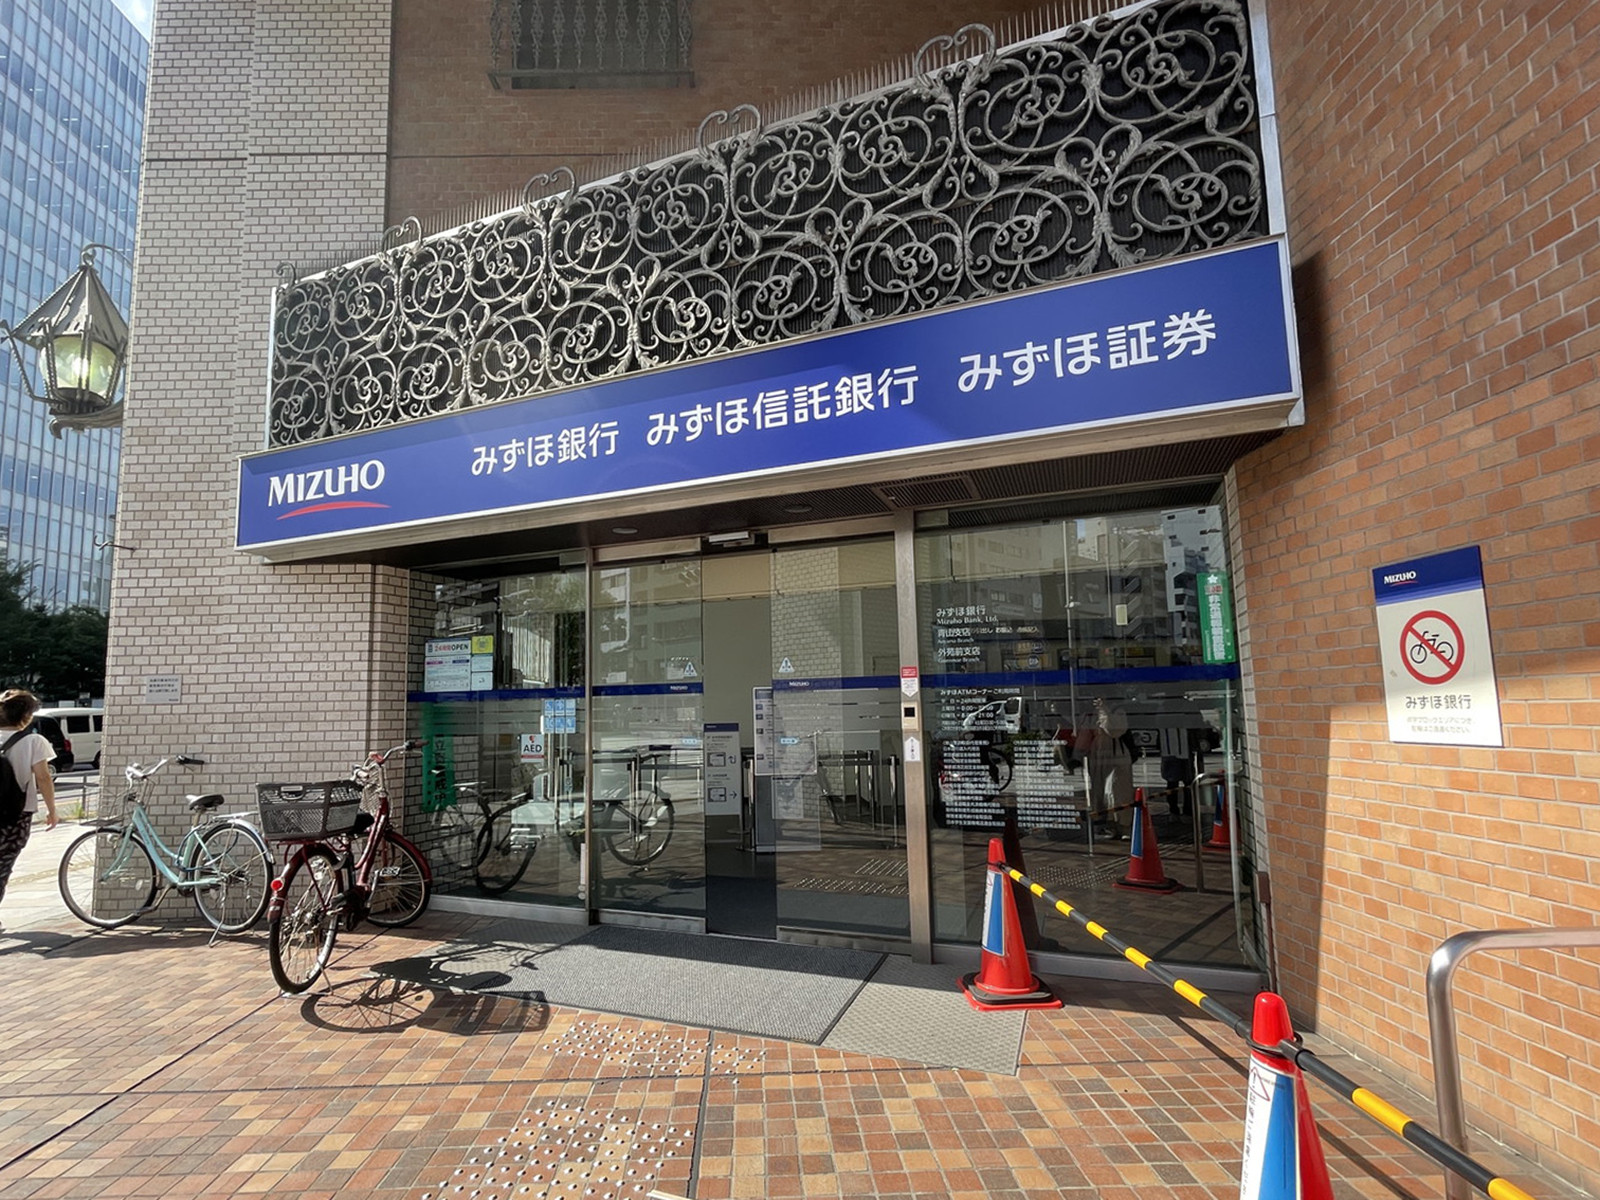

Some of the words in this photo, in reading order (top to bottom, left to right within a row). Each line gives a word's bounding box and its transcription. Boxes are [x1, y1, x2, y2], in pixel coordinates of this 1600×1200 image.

[471, 420, 619, 477] みずほ銀行
[646, 365, 919, 447] みずほ信託銀行
[957, 308, 1217, 393] みずほ証券
[268, 459, 386, 507] MIZUHO
[1384, 571, 1416, 584] MIZUHO
[936, 605, 986, 617] みずほ銀行
[1405, 694, 1472, 709] みずほ銀行
[523, 744, 543, 753] AED
